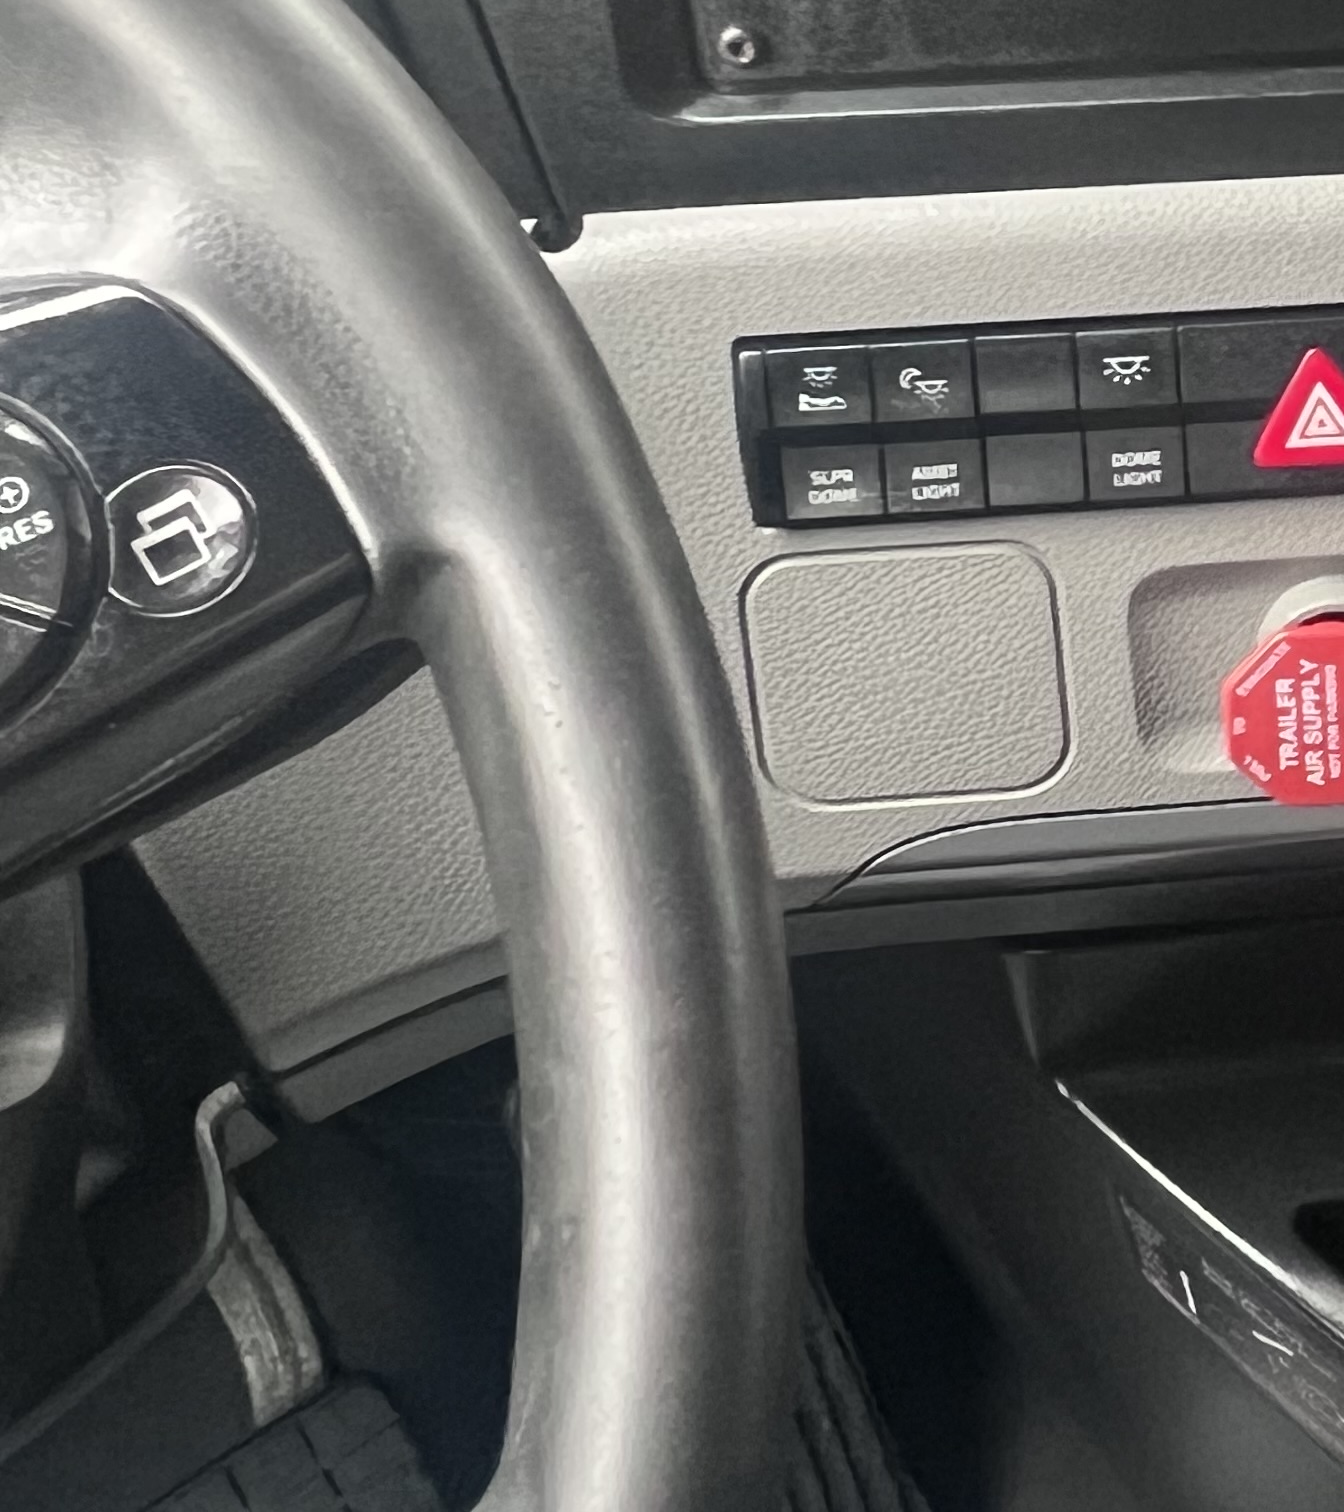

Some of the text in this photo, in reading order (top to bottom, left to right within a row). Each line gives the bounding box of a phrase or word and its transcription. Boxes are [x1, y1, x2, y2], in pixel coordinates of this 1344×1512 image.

[1113, 469, 1162, 487] LIGHT
[1275, 678, 1299, 770] TRAILER
[1299, 659, 1325, 785] AIR SUPPLY
